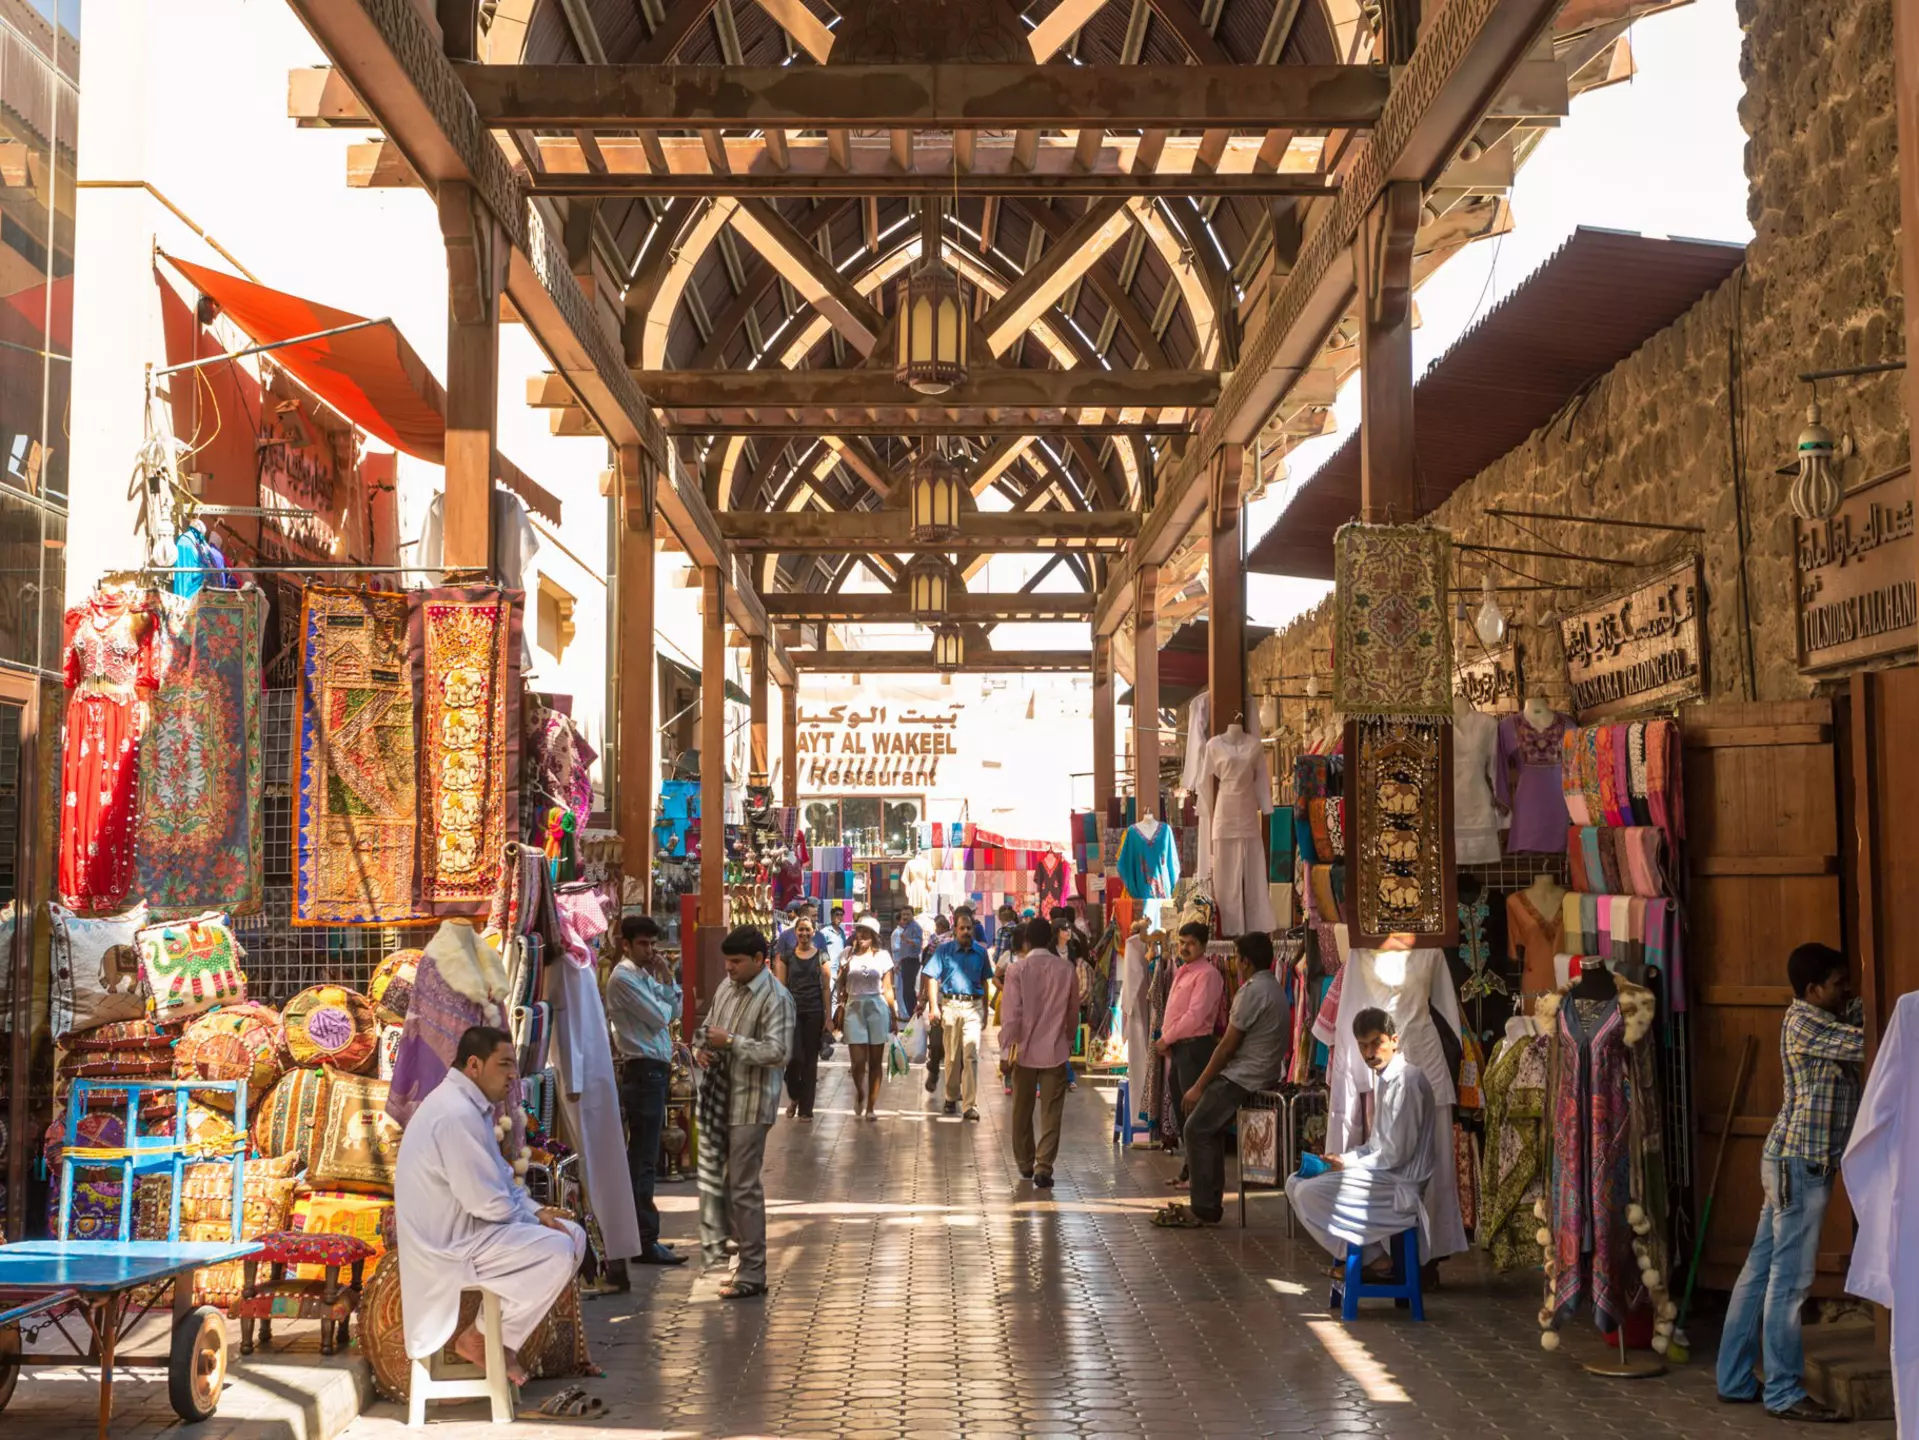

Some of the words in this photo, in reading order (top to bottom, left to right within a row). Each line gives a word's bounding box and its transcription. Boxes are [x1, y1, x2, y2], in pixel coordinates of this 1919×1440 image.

[1803, 597, 1854, 651] TULSIDAS
[1856, 579, 1917, 637] LALCHAND
[1622, 658, 1664, 697] TRADING
[898, 708, 957, 729] بيت
[796, 731, 836, 754] AYT
[841, 732, 867, 754] AL
[872, 732, 958, 755] WAKEEL
[809, 765, 938, 788] Restaurant
